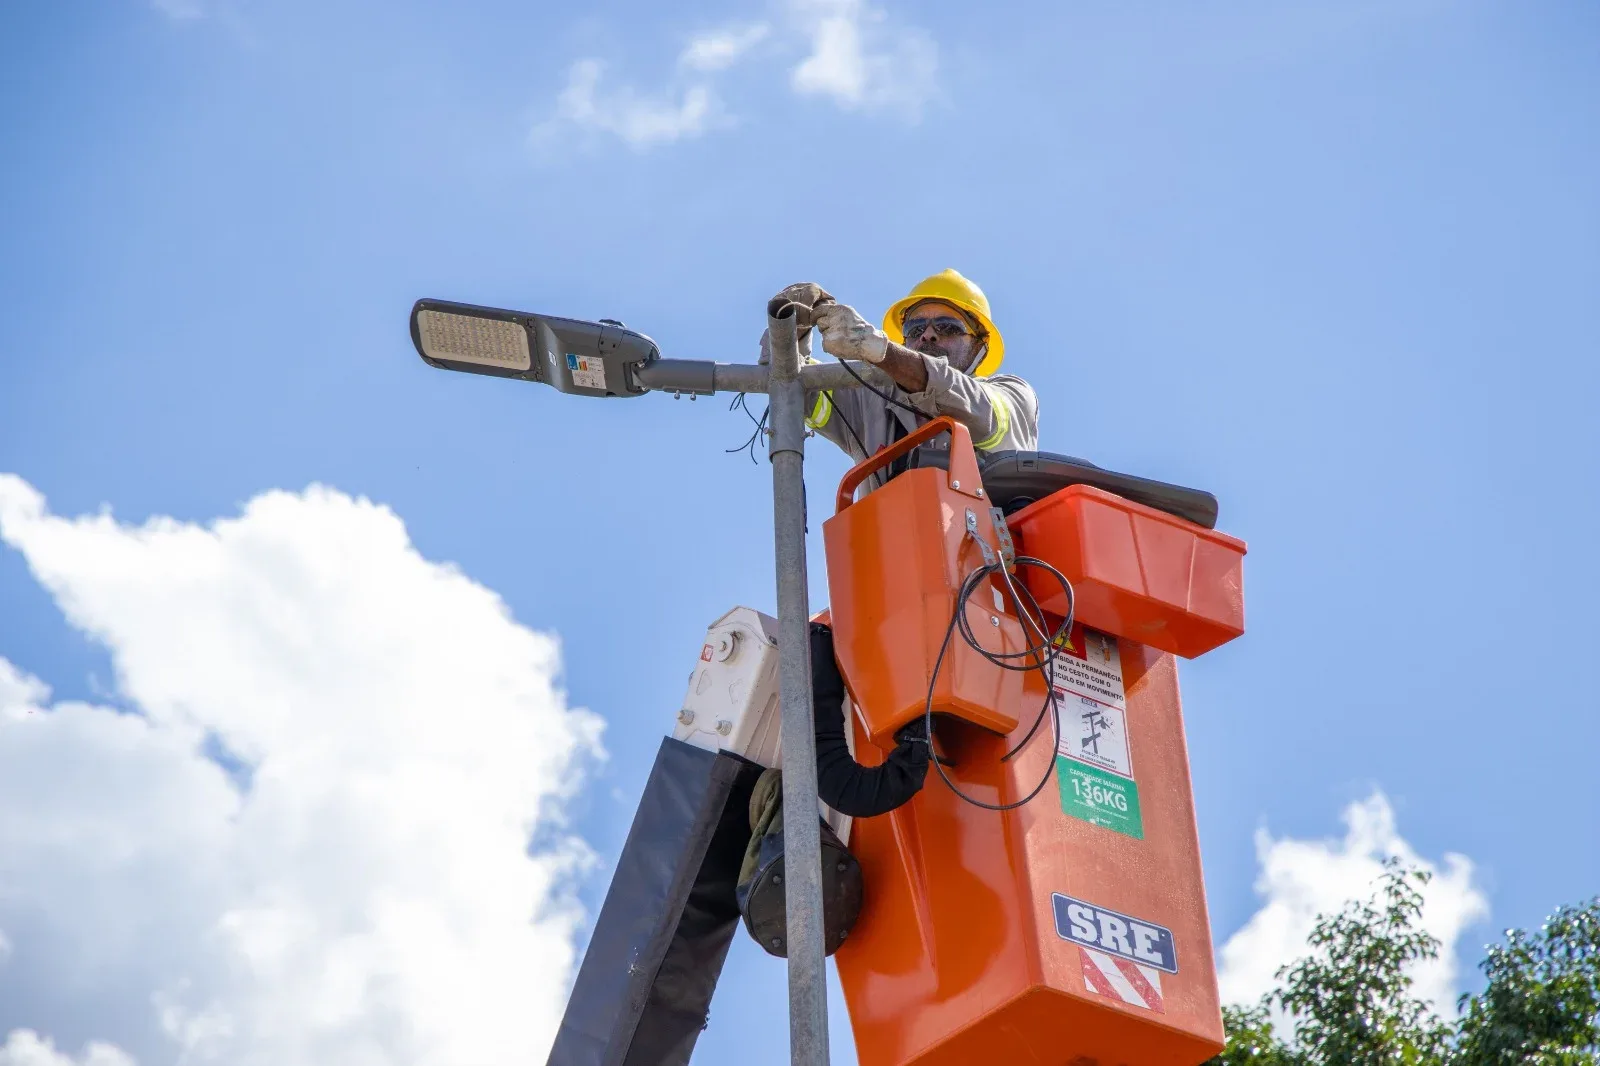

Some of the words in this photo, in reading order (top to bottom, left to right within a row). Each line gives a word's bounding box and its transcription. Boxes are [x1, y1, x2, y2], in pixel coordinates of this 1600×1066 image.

[1045, 649, 1075, 666] PIBIDA
[1058, 664, 1067, 672] NO
[1069, 668, 1090, 680] CESTO
[1091, 675, 1105, 686] COM
[1076, 680, 1086, 688] EM
[1087, 683, 1124, 702] MOVIMENTO
[1069, 768, 1103, 785] CAPACIDADE
[1071, 778, 1128, 812] 136KG
[1067, 903, 1164, 966] SRE
